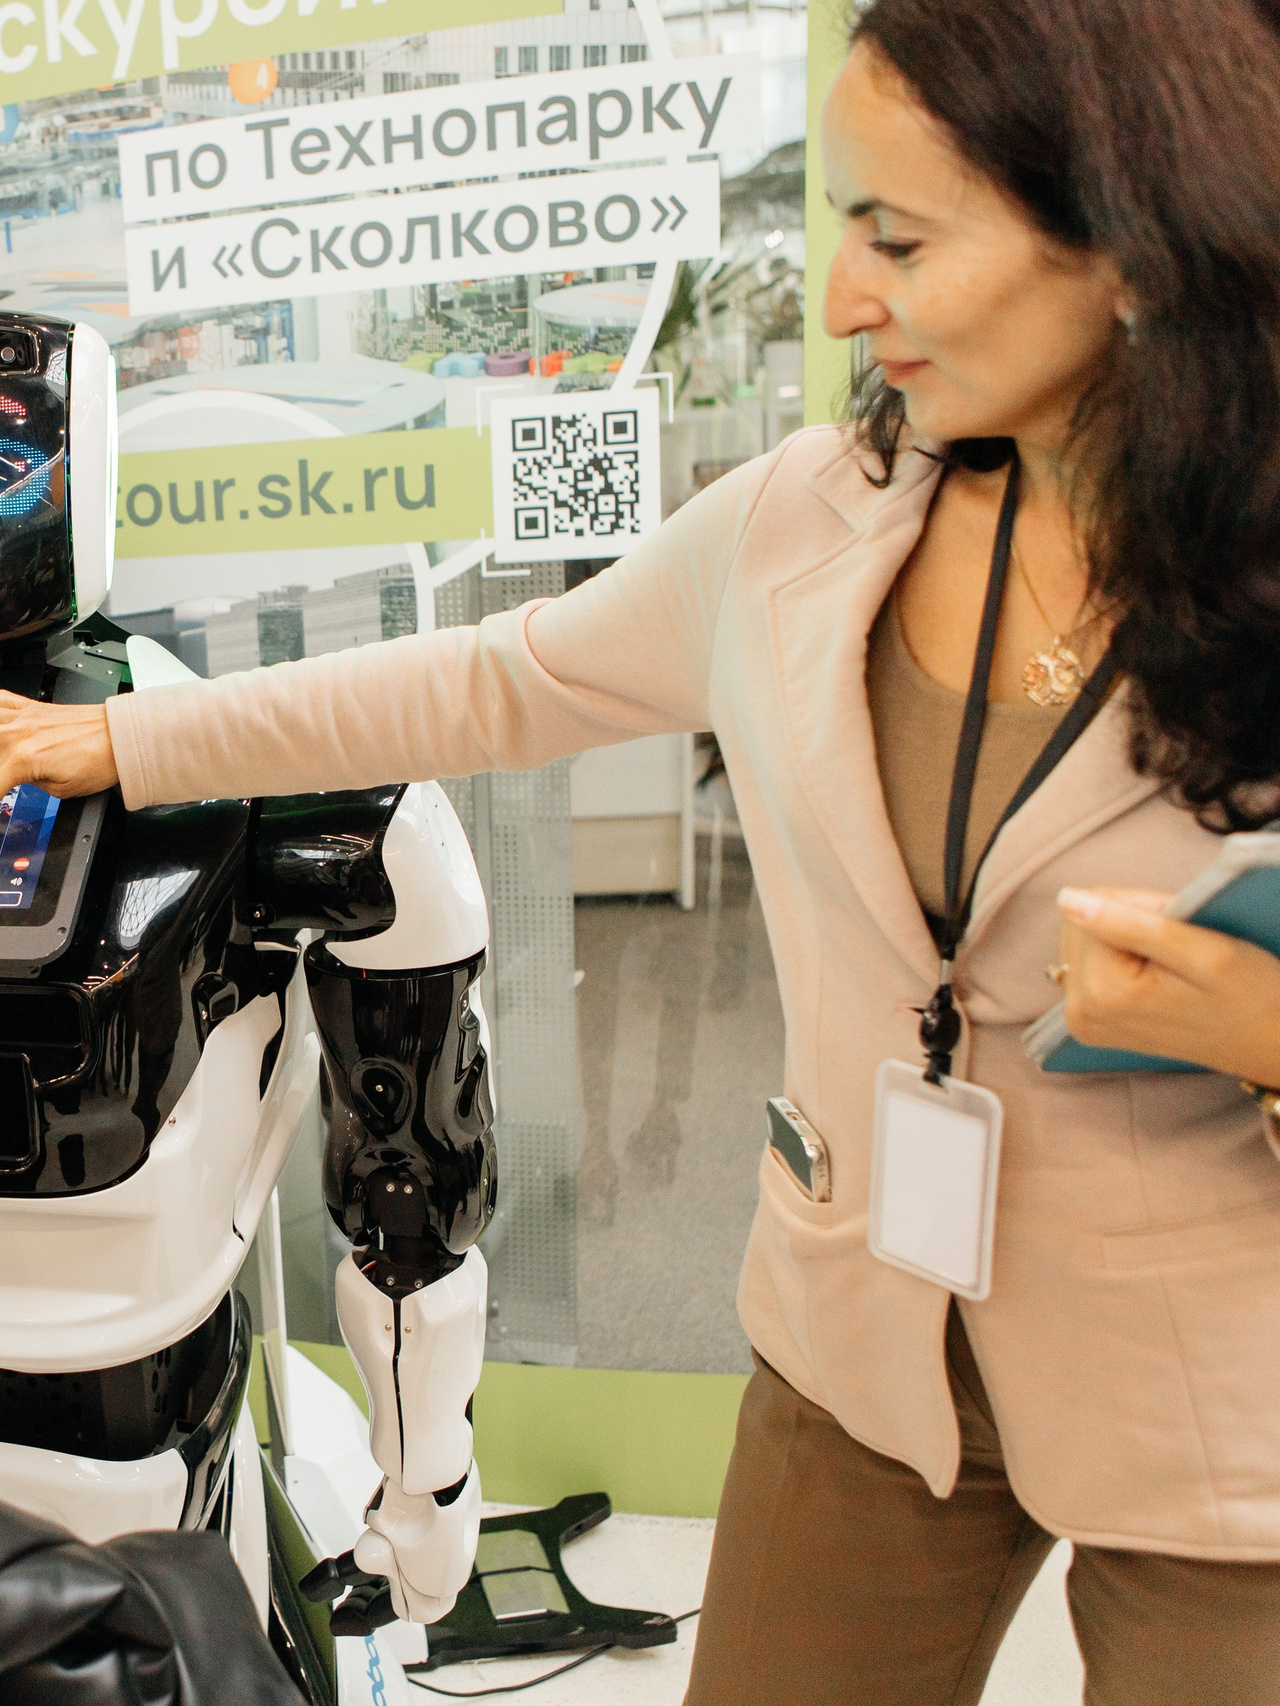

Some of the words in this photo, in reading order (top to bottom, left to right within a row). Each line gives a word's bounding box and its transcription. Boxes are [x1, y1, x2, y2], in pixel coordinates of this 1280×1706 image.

[145, 141, 228, 197] по
[245, 77, 732, 180] Технопарку
[151, 246, 187, 292] и
[212, 194, 688, 279] «Сколково»
